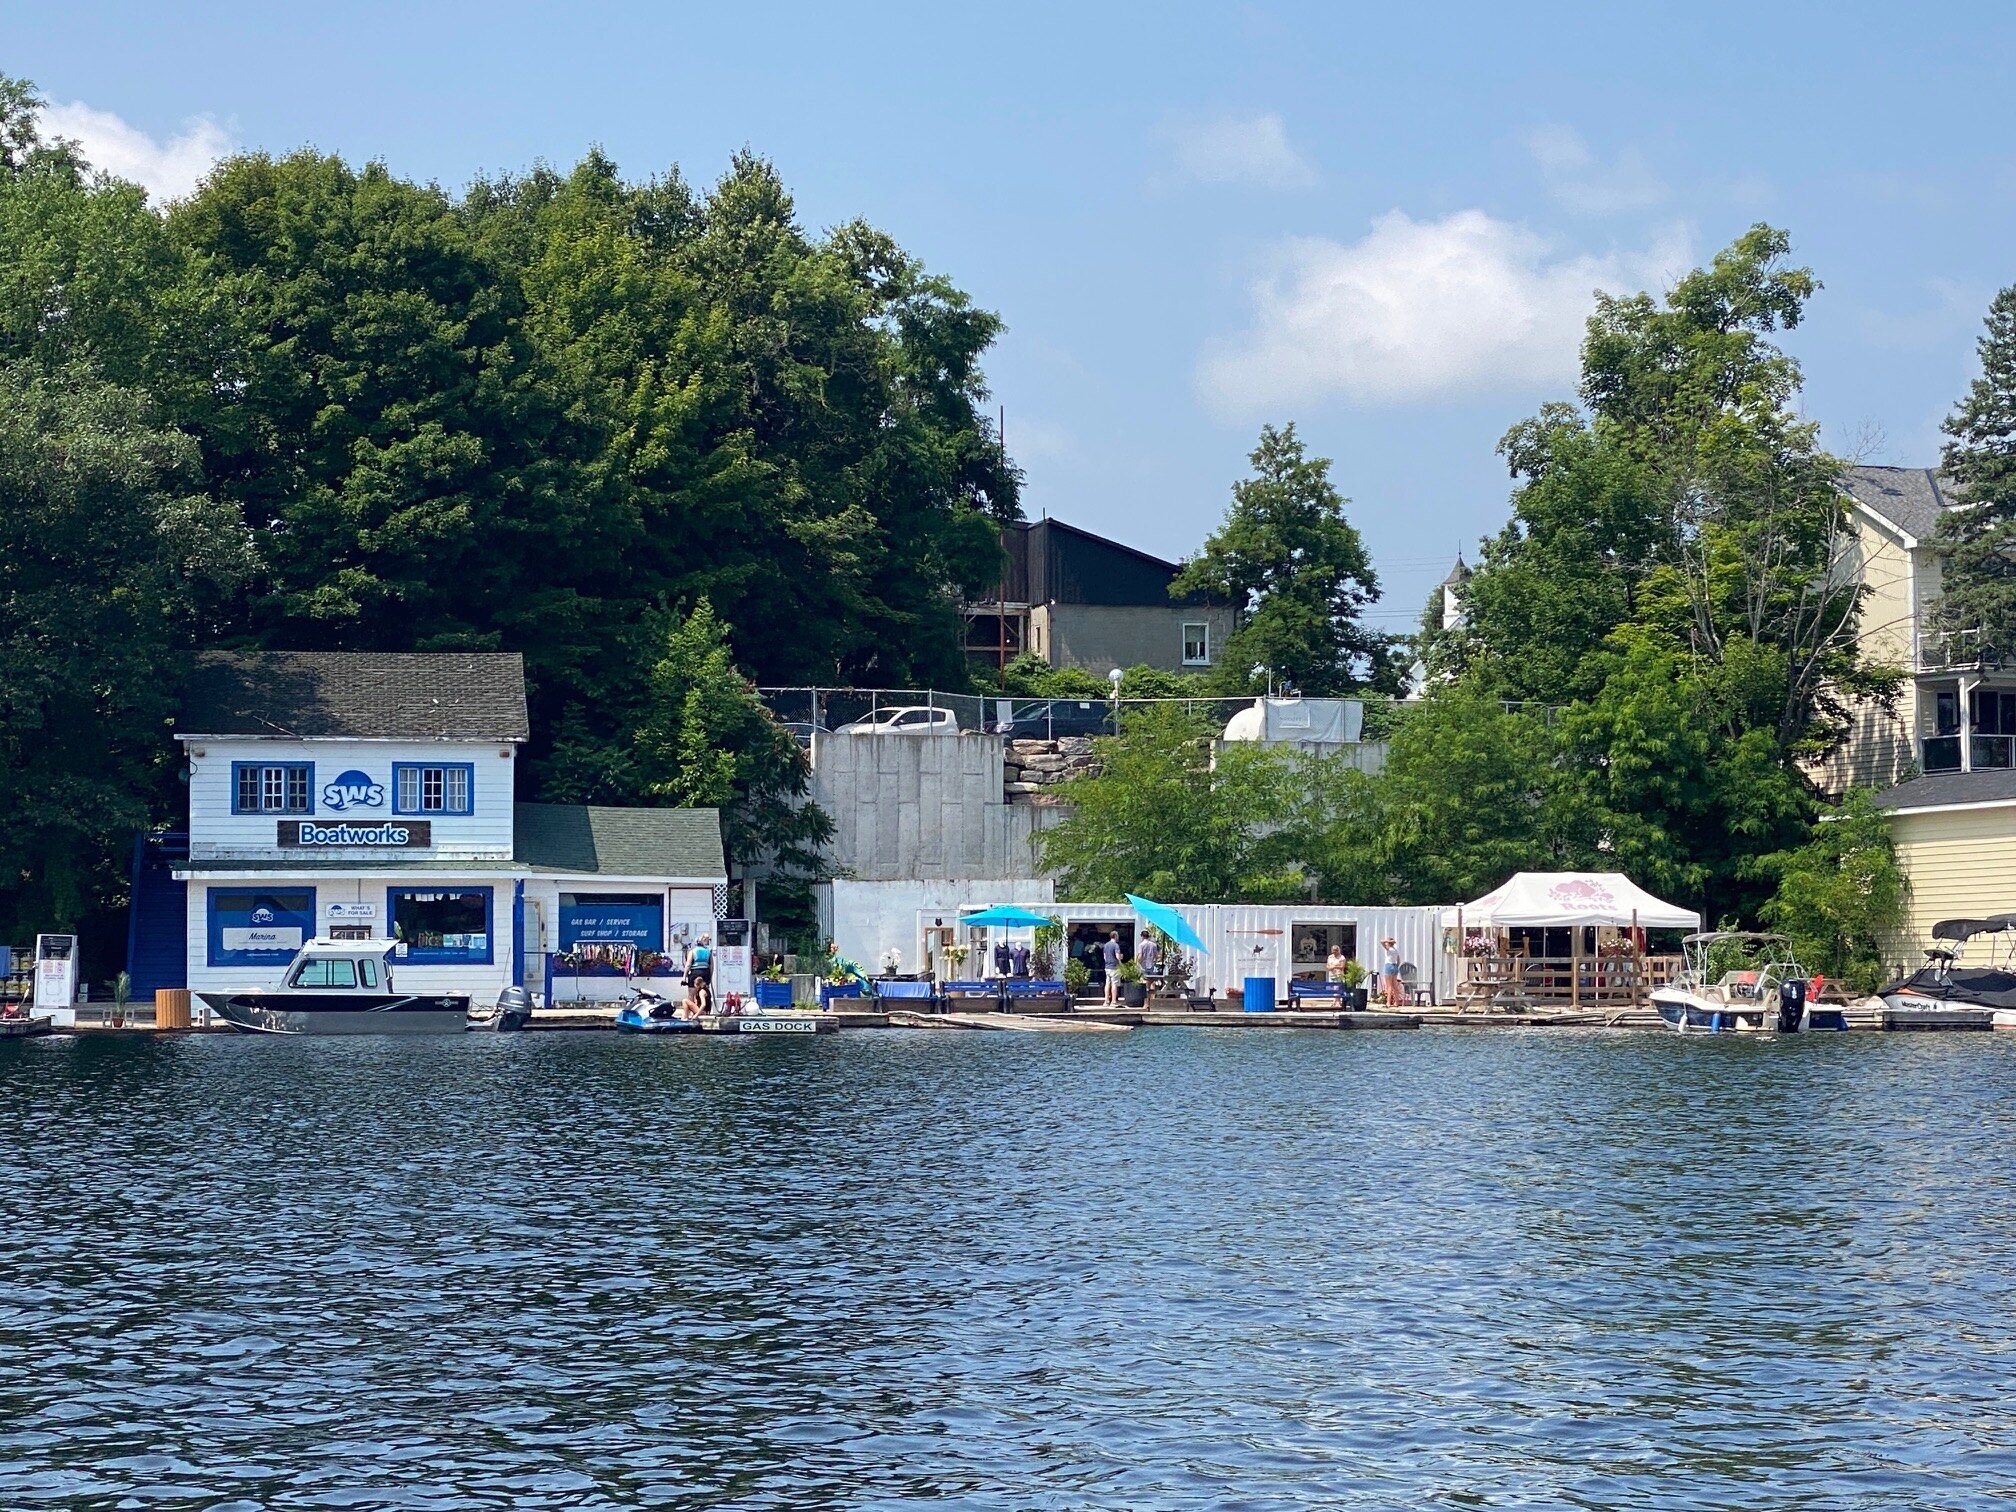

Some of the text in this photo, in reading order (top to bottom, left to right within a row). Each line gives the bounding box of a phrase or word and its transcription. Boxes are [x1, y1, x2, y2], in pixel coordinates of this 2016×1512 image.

[323, 783, 385, 808] SWS
[300, 823, 409, 843] Boatworks
[1560, 903, 1618, 911] Roots
[252, 913, 273, 922] SWS
[248, 933, 277, 941] Marina
[743, 1022, 812, 1030] GAS DOCK
